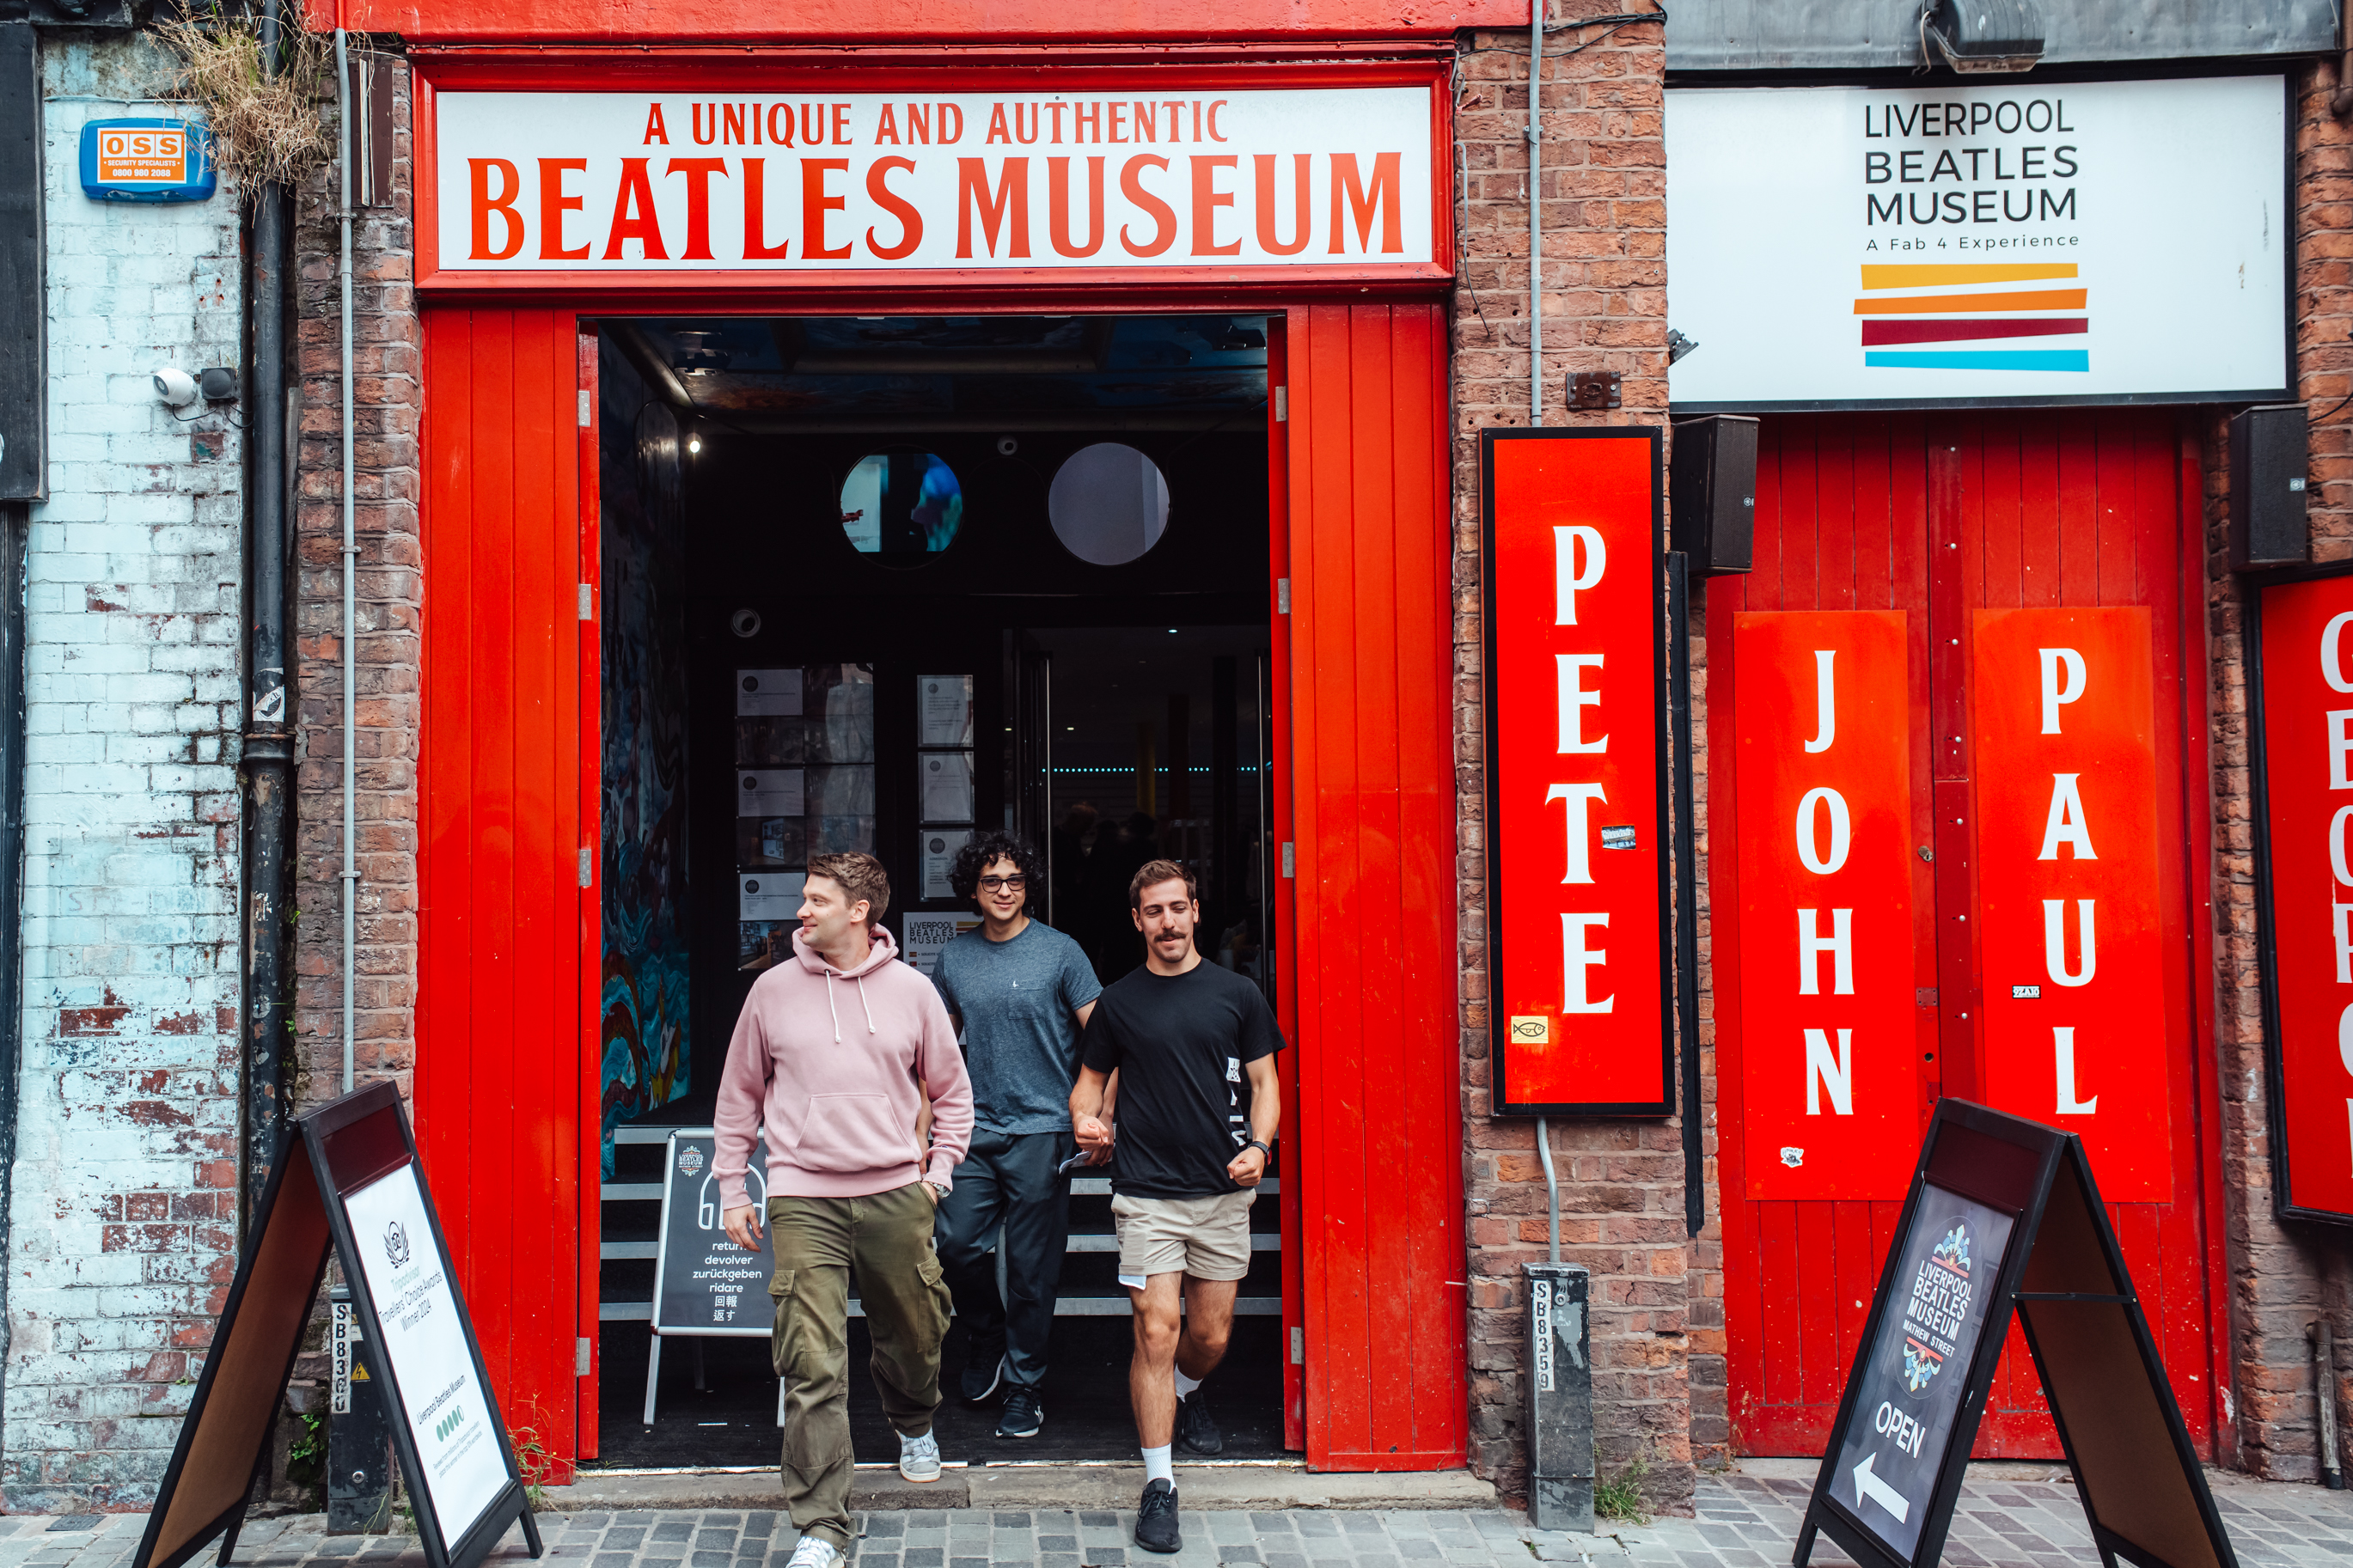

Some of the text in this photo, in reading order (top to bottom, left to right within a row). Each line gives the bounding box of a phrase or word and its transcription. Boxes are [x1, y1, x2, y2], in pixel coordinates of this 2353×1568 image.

[643, 101, 1227, 149] A UNIQUE AND AUTHENTIC
[1866, 100, 2075, 137] LIVERPOOL
[107, 137, 178, 155] OSS
[1866, 145, 2078, 184] BEATLES
[468, 152, 1404, 259] BEATLES MUSEUM
[1867, 187, 2075, 226] MUSEUM
[1867, 235, 2079, 251] A Fab 4 Experience
[1545, 526, 1614, 1014] PETE
[1796, 650, 1855, 1115] JOHN
[2037, 648, 2099, 1114] PAUL
[391, 1266, 419, 1293] Tripadvisor
[693, 1269, 761, 1282] zurückgeben
[705, 1255, 753, 1265] devolver
[405, 1285, 424, 1305] Choice
[423, 1270, 442, 1292] Awards
[709, 1283, 743, 1292] ridare
[1913, 1276, 1968, 1321] BEATLES
[1918, 1260, 1971, 1302] LIVERPOOL
[400, 1298, 431, 1332] Winner 2024
[713, 1309, 735, 1321] 返す
[715, 1296, 737, 1307] 回報
[1907, 1296, 1959, 1341] MUSEUM
[1537, 1284, 1549, 1388] SB8359
[1903, 1319, 1955, 1358] MATHEW STREET
[417, 1399, 437, 1425] Liverpool
[449, 1375, 466, 1394] Museum
[1875, 1400, 1926, 1459] OPEN
